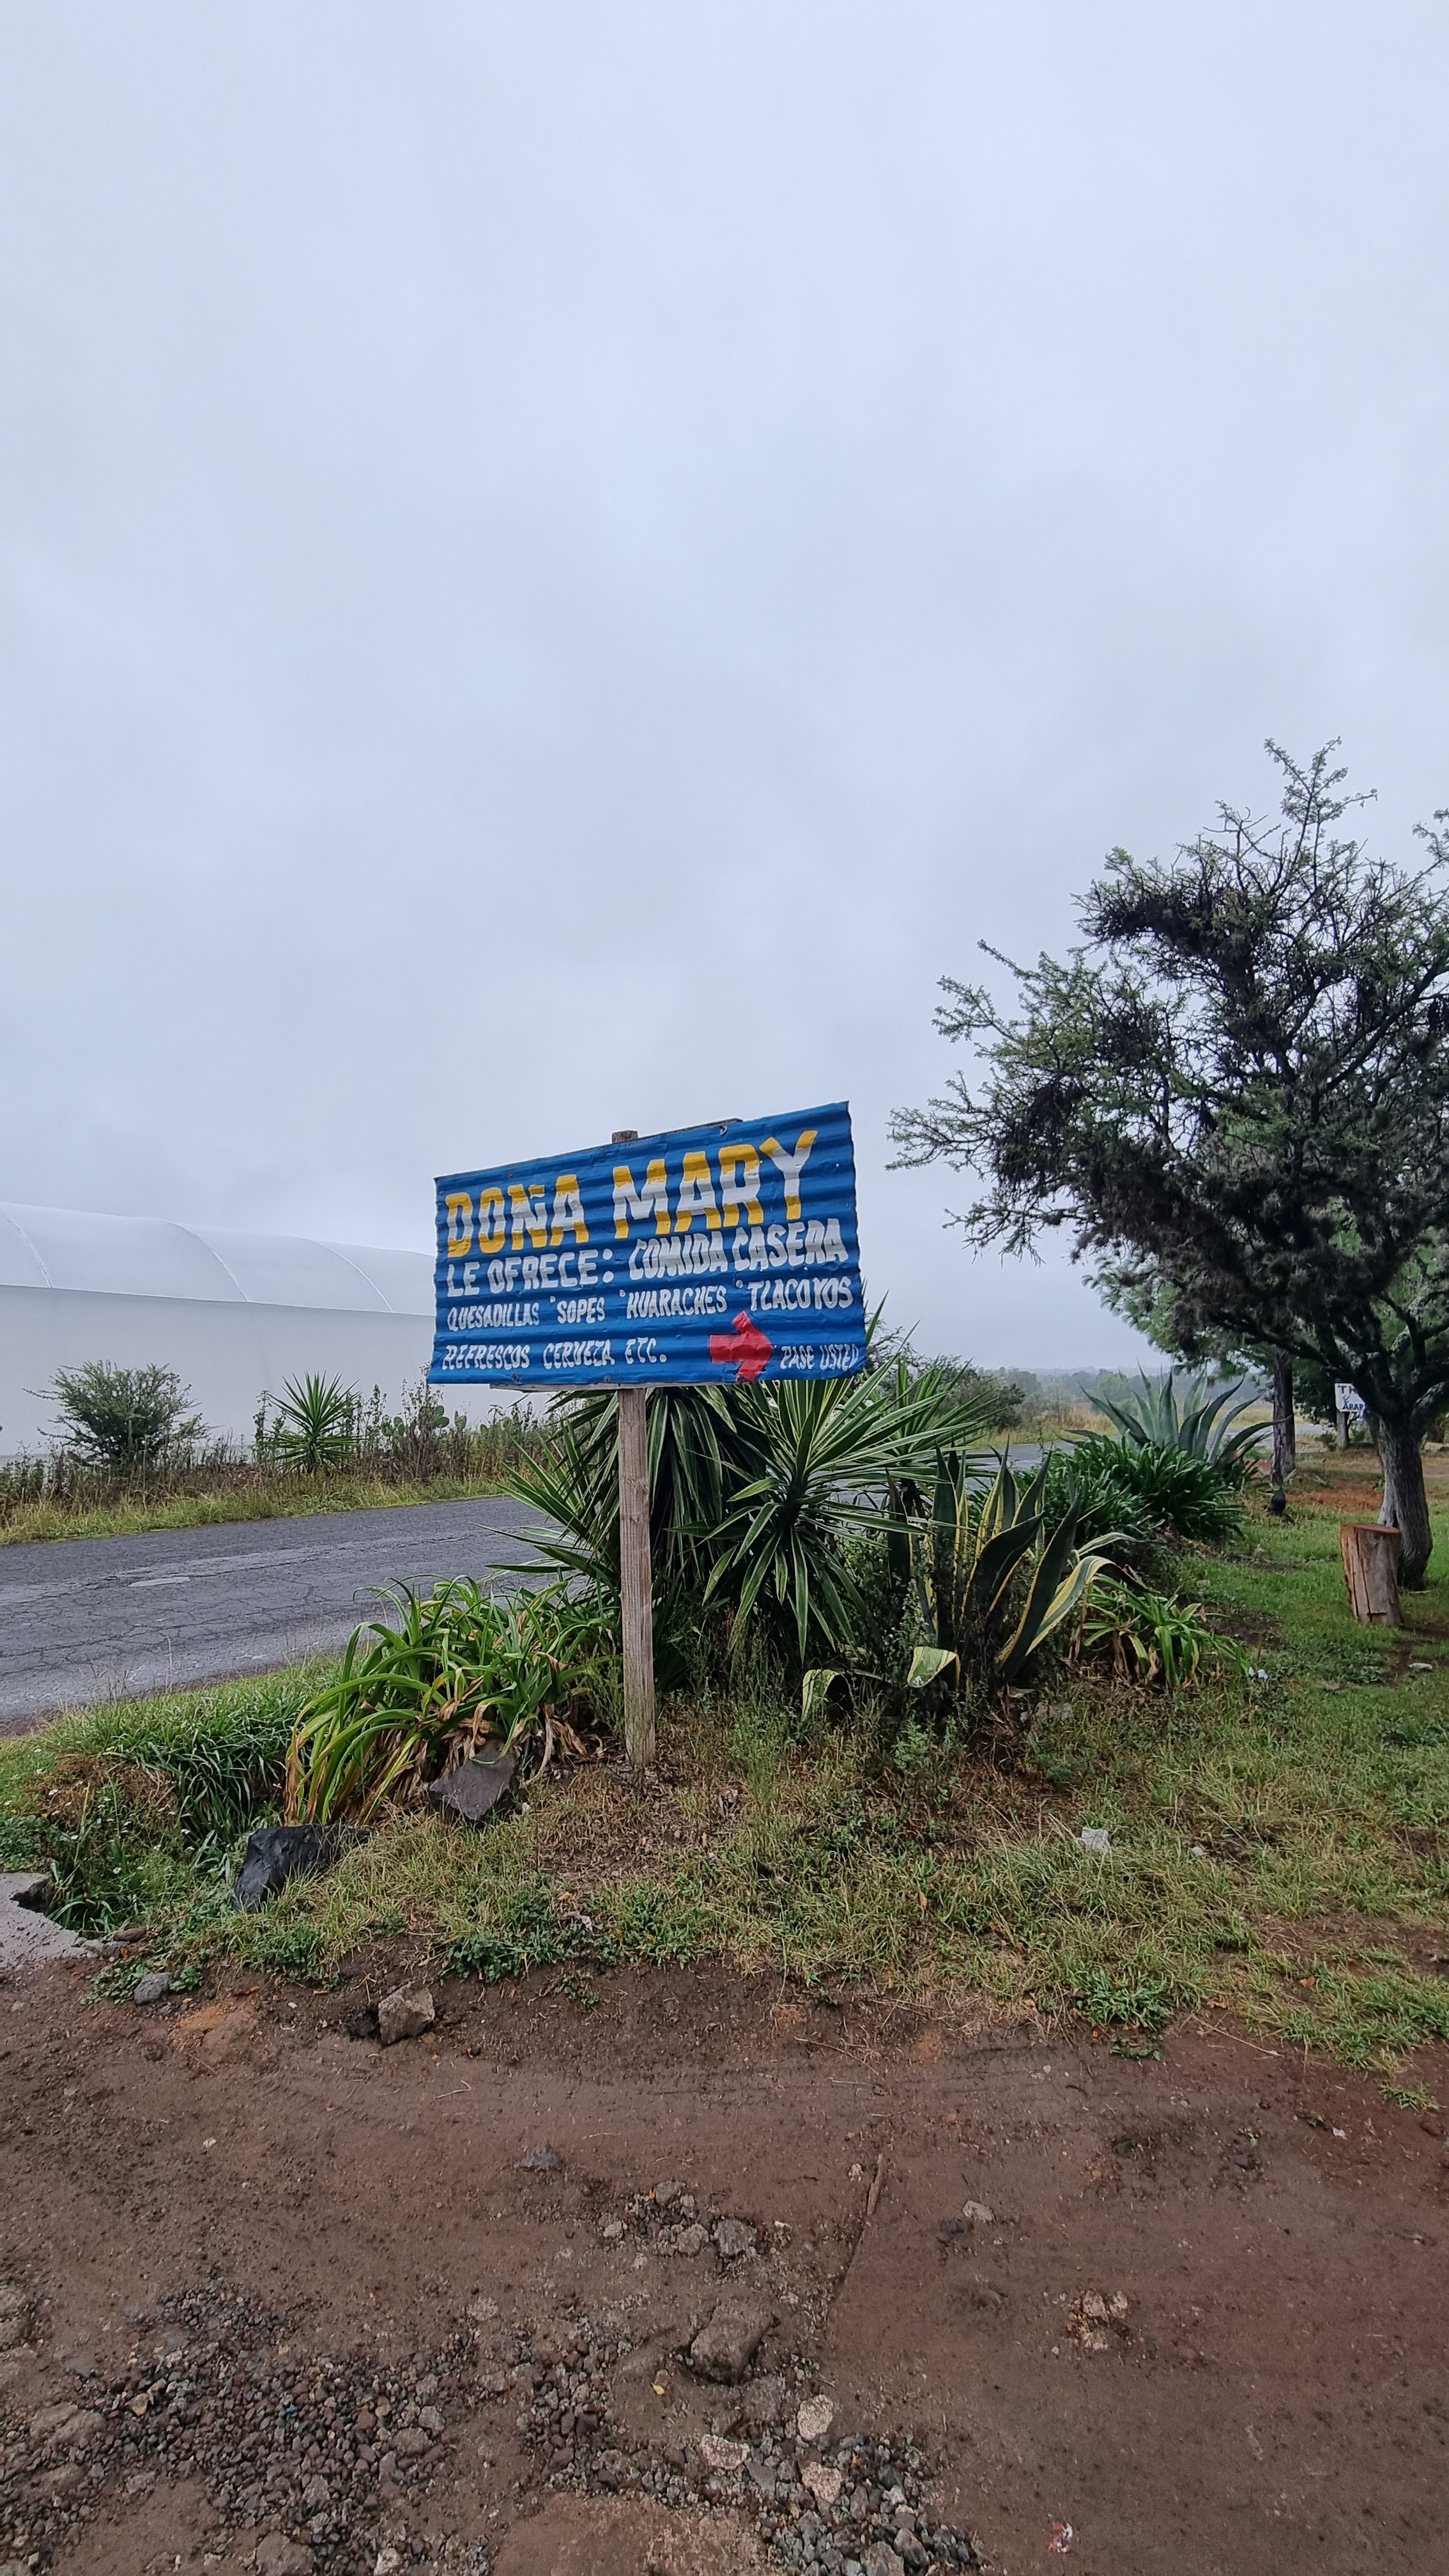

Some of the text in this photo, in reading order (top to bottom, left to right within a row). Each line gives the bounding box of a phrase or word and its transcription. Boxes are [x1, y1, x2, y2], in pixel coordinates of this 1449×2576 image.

[445, 1130, 818, 1258] DOÑA MARY
[447, 1218, 848, 1297] LE OFRECE: COMIDA CASERA
[447, 1276, 854, 1331] QUESADILLAS SOPES HUARACHES TLACOYOS
[442, 1337, 667, 1370] REFRESCOS CERVEZA ETC.
[780, 1344, 859, 1372] PASE USTED
